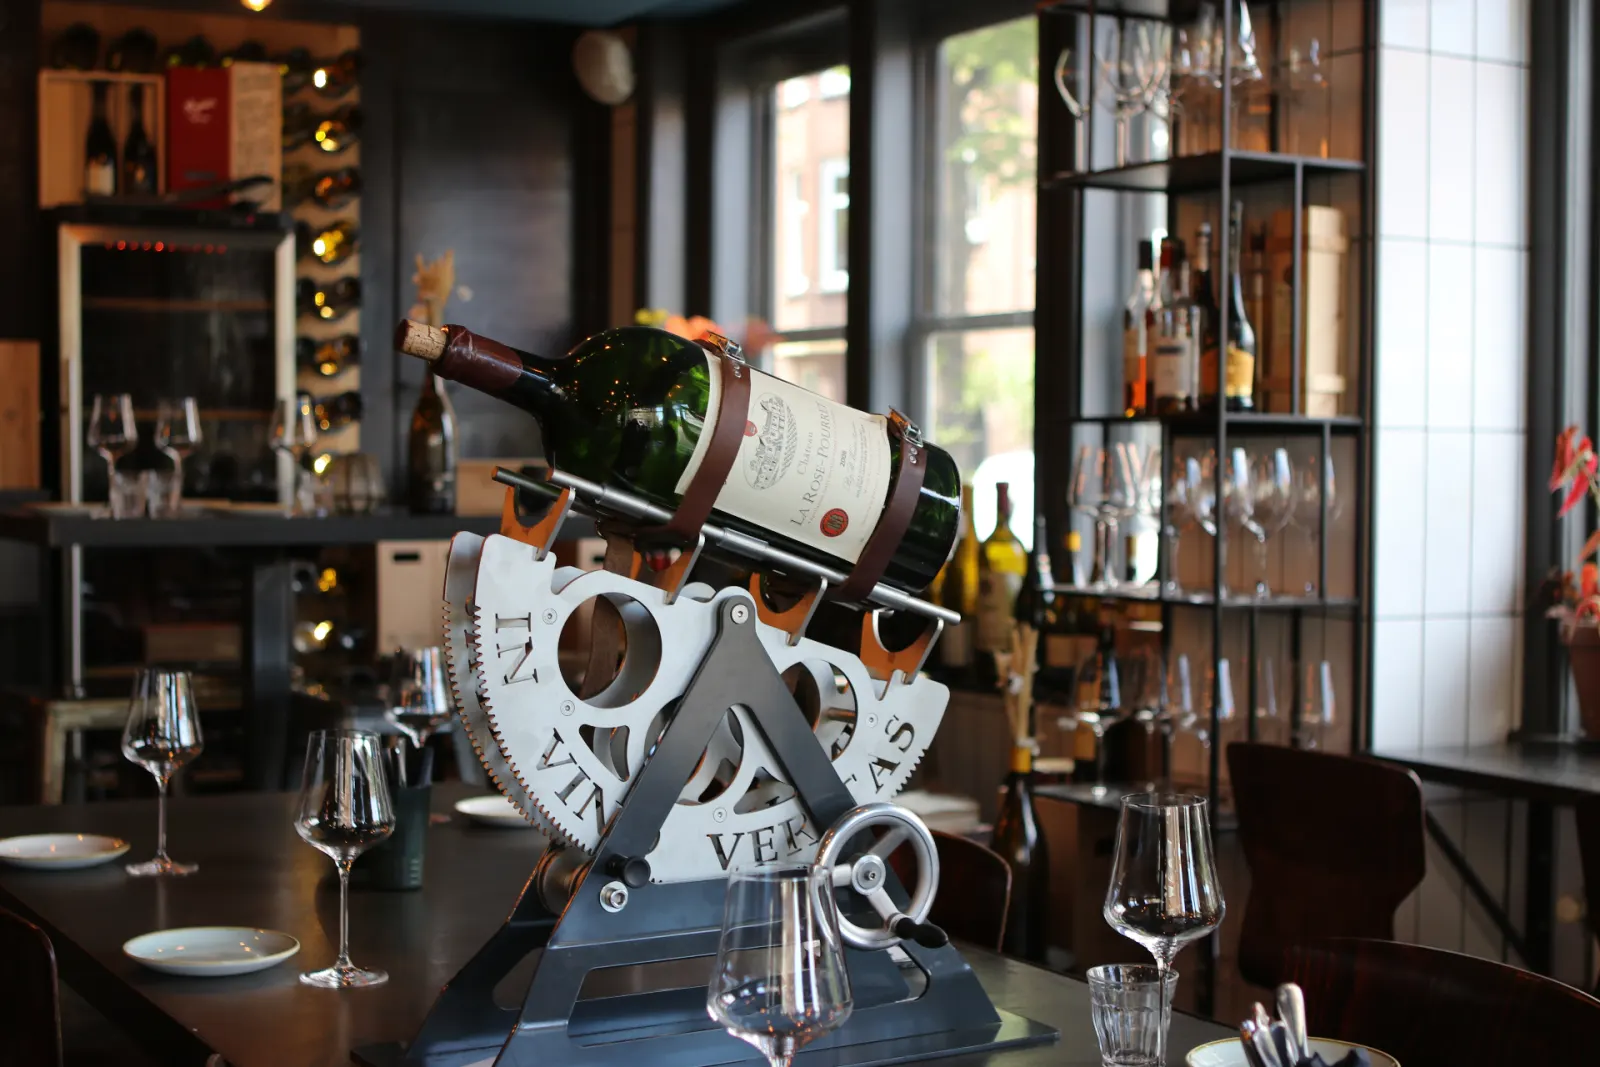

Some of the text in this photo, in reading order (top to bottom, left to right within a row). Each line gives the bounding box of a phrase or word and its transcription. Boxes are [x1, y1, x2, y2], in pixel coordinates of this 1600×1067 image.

[790, 509, 810, 526] LA
[495, 612, 538, 686] IN
[536, 727, 624, 838] VIN
